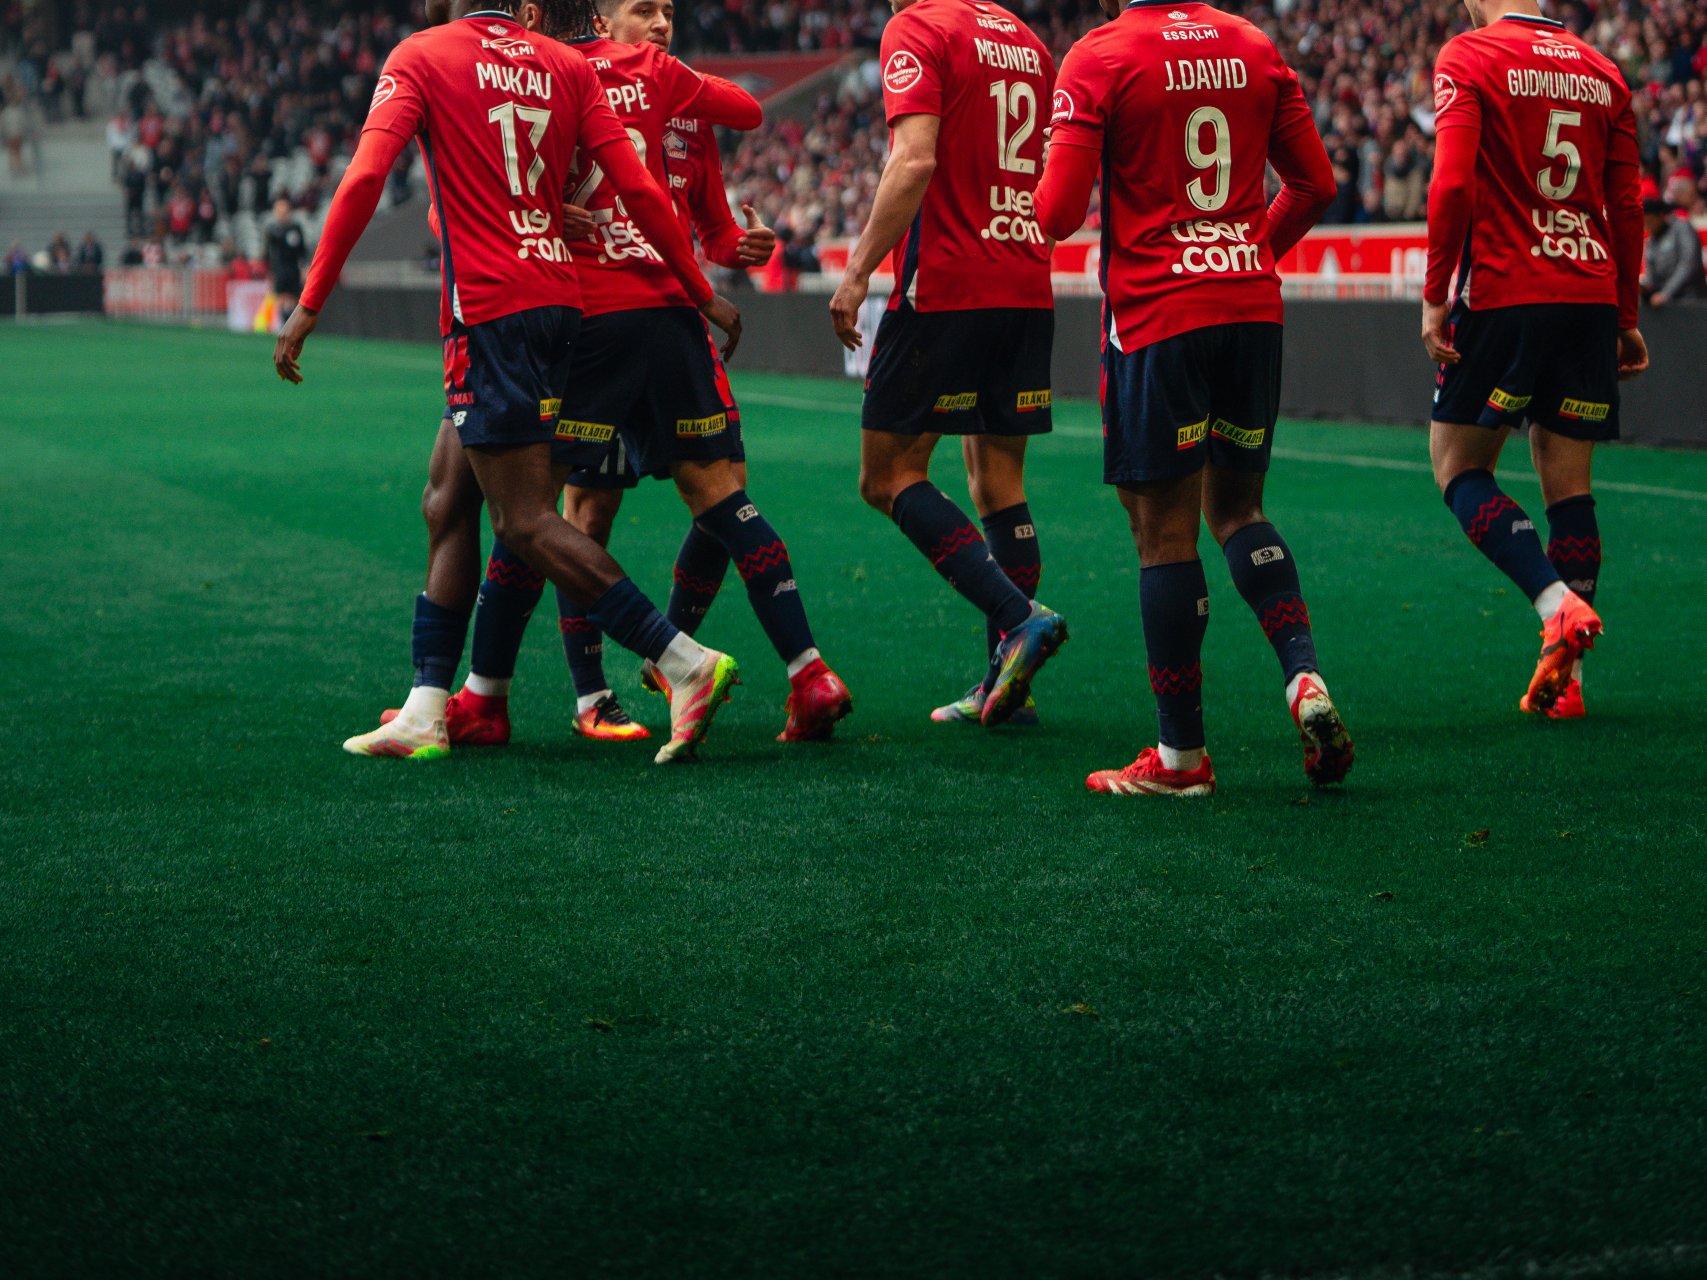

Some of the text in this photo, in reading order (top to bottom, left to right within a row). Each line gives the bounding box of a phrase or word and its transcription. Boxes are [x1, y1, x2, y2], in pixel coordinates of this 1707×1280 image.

[1162, 28, 1219, 42] ESSALMI
[974, 38, 1042, 77] MEUNIER
[1532, 45, 1581, 60] ESSALMI
[475, 61, 552, 100] MUKAU
[1165, 57, 1248, 91] J.DAVID
[1507, 68, 1612, 107] GUDMUNDSSON
[989, 79, 1036, 175] 12
[488, 101, 552, 196] 17
[1184, 106, 1232, 211] 9
[1537, 108, 1581, 200] 5
[981, 216, 1046, 244] .com
[1170, 220, 1250, 243] user
[1532, 208, 1591, 236] user
[1171, 242, 1262, 274] .com
[1530, 235, 1608, 261] .com
